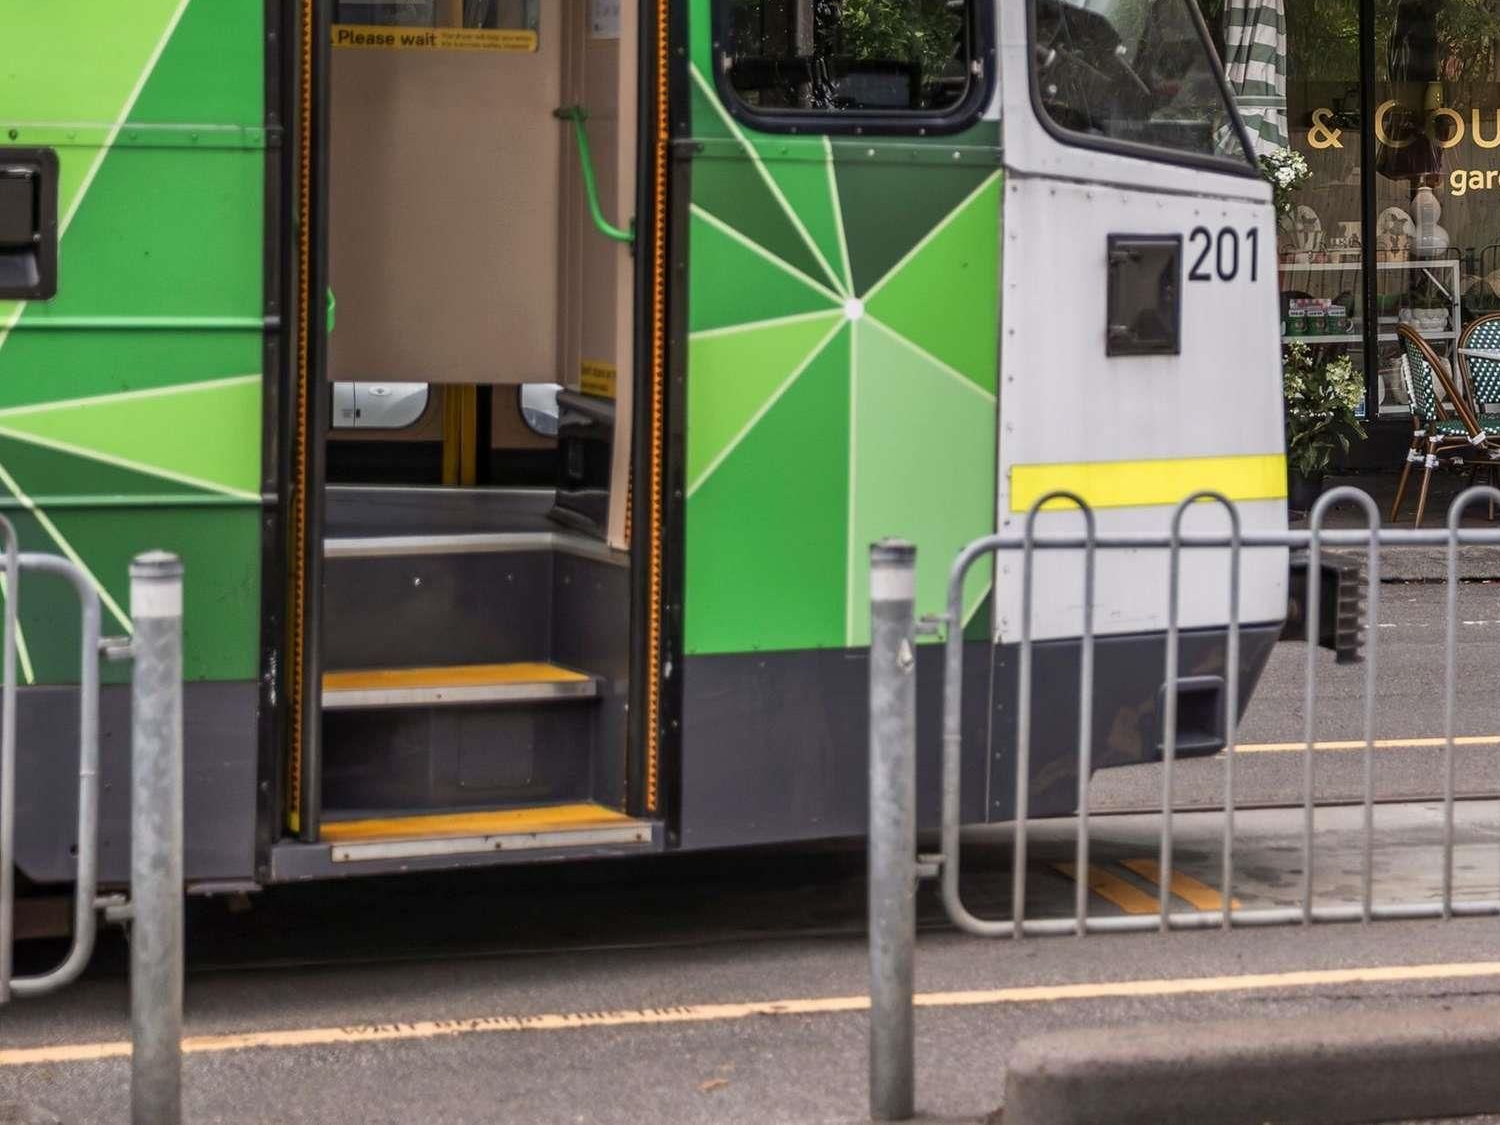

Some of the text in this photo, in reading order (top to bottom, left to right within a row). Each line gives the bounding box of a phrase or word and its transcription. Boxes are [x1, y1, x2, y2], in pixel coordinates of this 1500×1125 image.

[338, 30, 395, 45] Please
[401, 32, 436, 46] wait
[1307, 107, 1344, 149] &
[1188, 226, 1259, 282] 201
